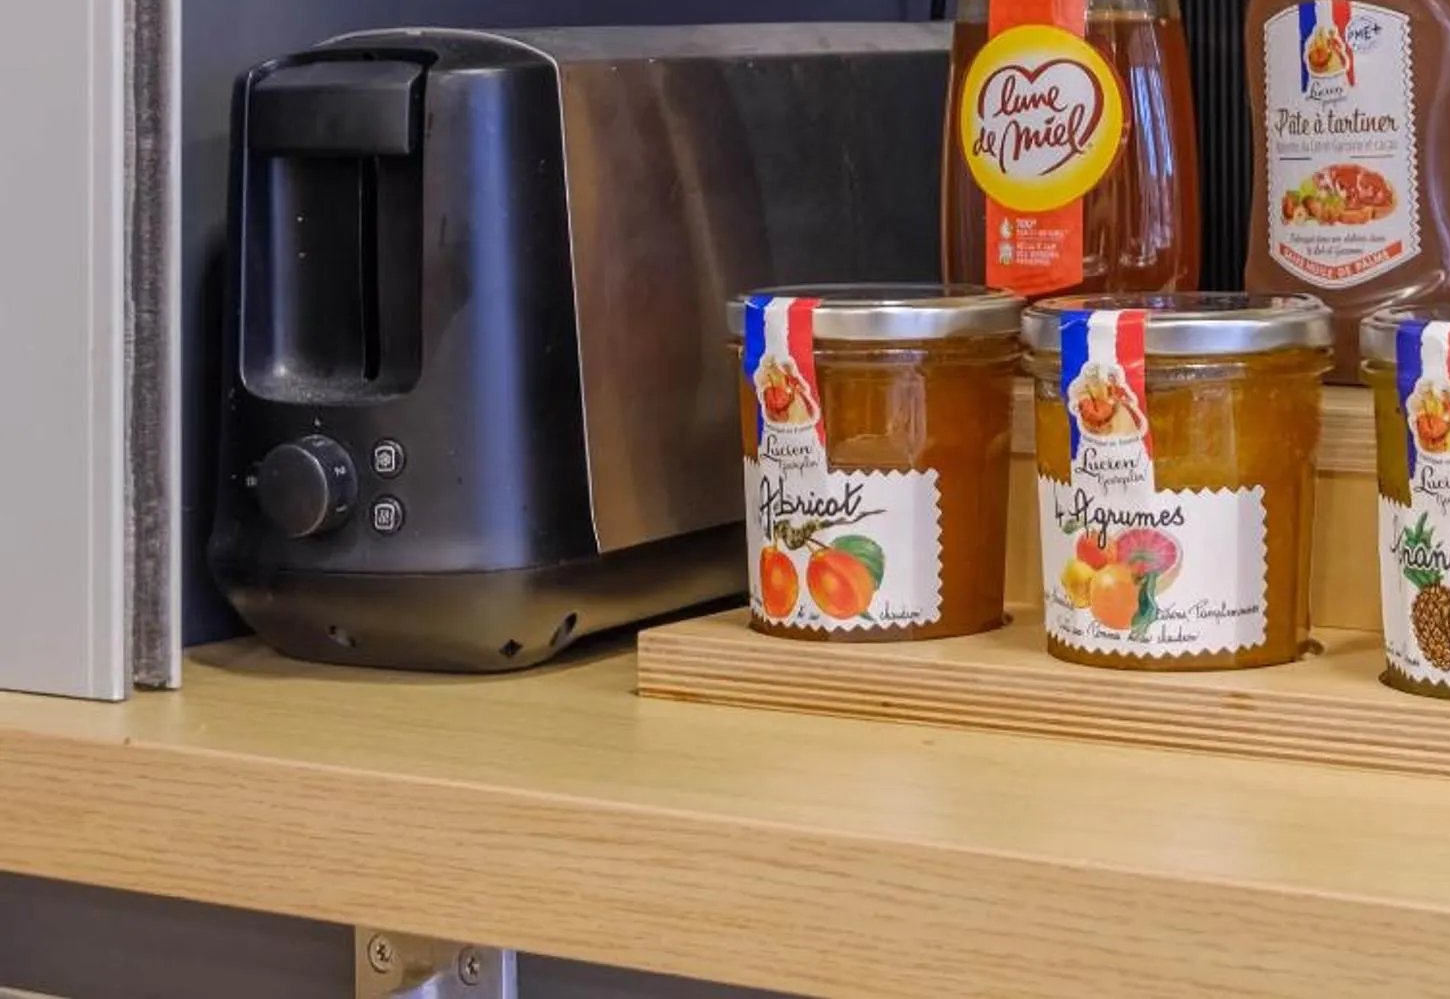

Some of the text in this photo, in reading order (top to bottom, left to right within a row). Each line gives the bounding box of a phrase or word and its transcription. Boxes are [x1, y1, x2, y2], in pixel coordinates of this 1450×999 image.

[993, 75, 1068, 118] lune
[972, 122, 998, 160] de
[1274, 107, 1400, 138] Pâte à tartiner
[1074, 447, 1141, 478] Lucien
[759, 475, 865, 540] Abricot
[1068, 487, 1186, 550] Agrumes
